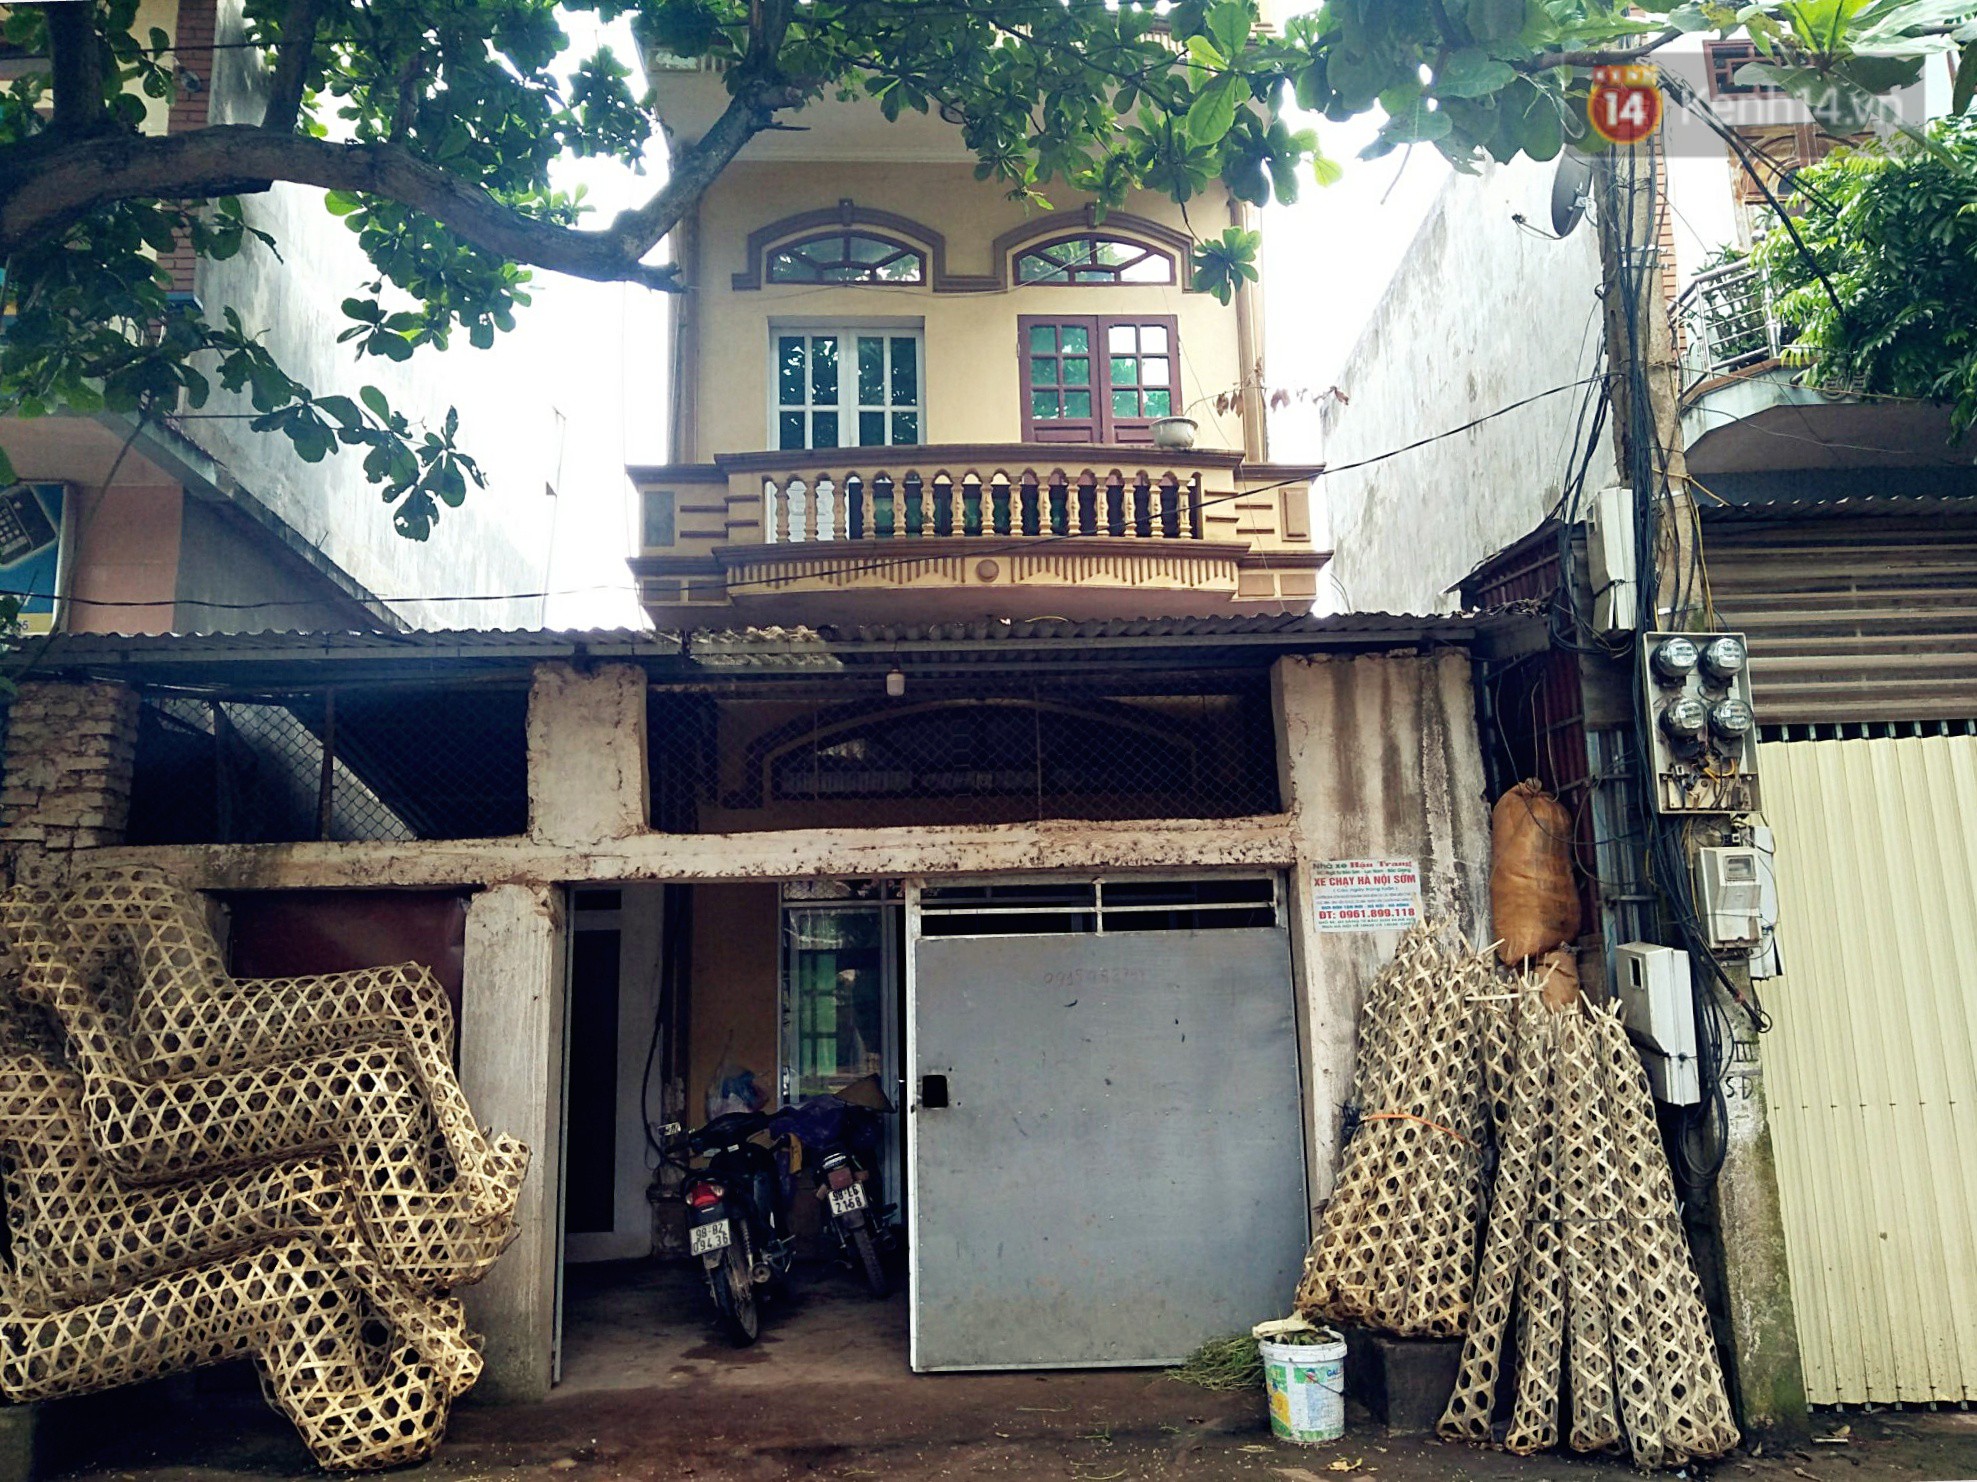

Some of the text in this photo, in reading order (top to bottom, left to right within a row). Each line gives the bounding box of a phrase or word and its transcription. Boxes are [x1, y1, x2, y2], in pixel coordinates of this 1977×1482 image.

[1314, 877, 1326, 887] XE
[1329, 877, 1354, 889] CHẠY
[1357, 874, 1371, 885] HÀ
[1374, 874, 1390, 886] NỘI
[1318, 910, 1336, 919] ĐT:
